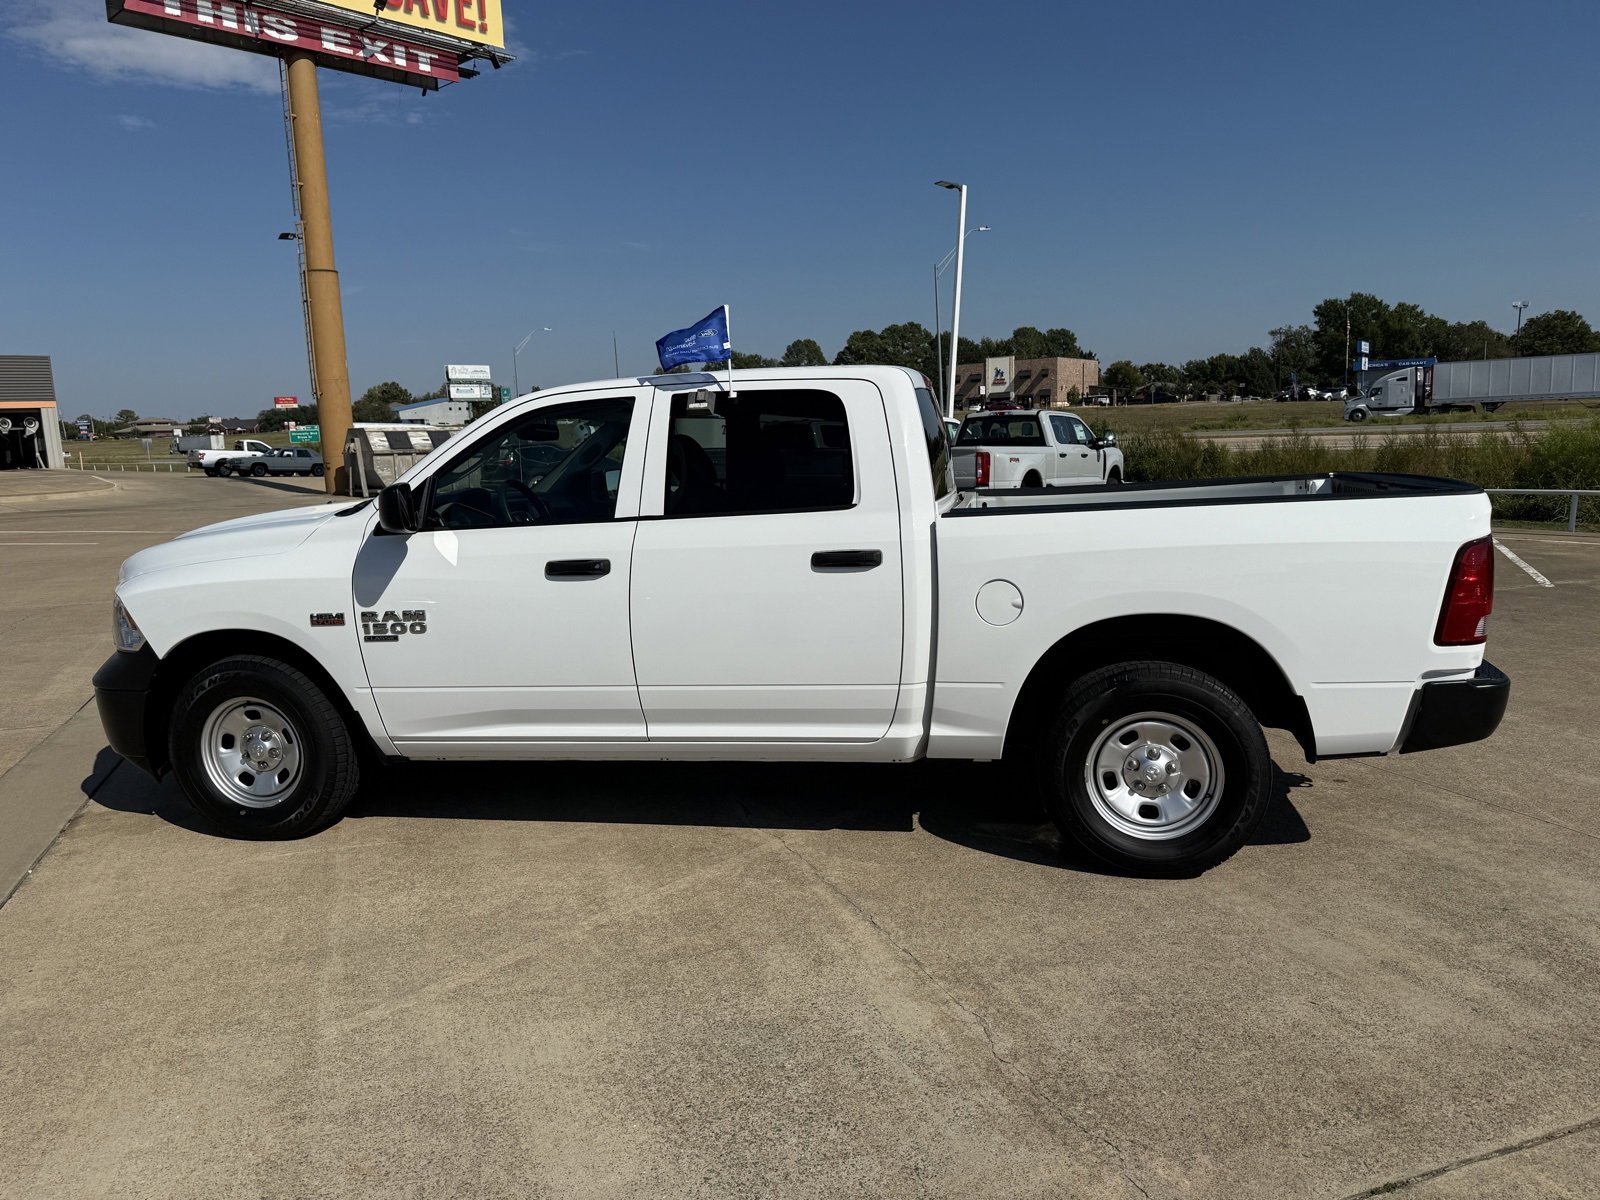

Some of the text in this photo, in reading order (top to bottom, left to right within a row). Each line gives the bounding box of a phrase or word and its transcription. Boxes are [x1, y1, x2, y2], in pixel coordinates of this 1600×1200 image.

[321, 26, 438, 72] EXIT
[310, 612, 345, 620] HEMI
[361, 610, 426, 622] RAM
[362, 622, 428, 635] 1500
